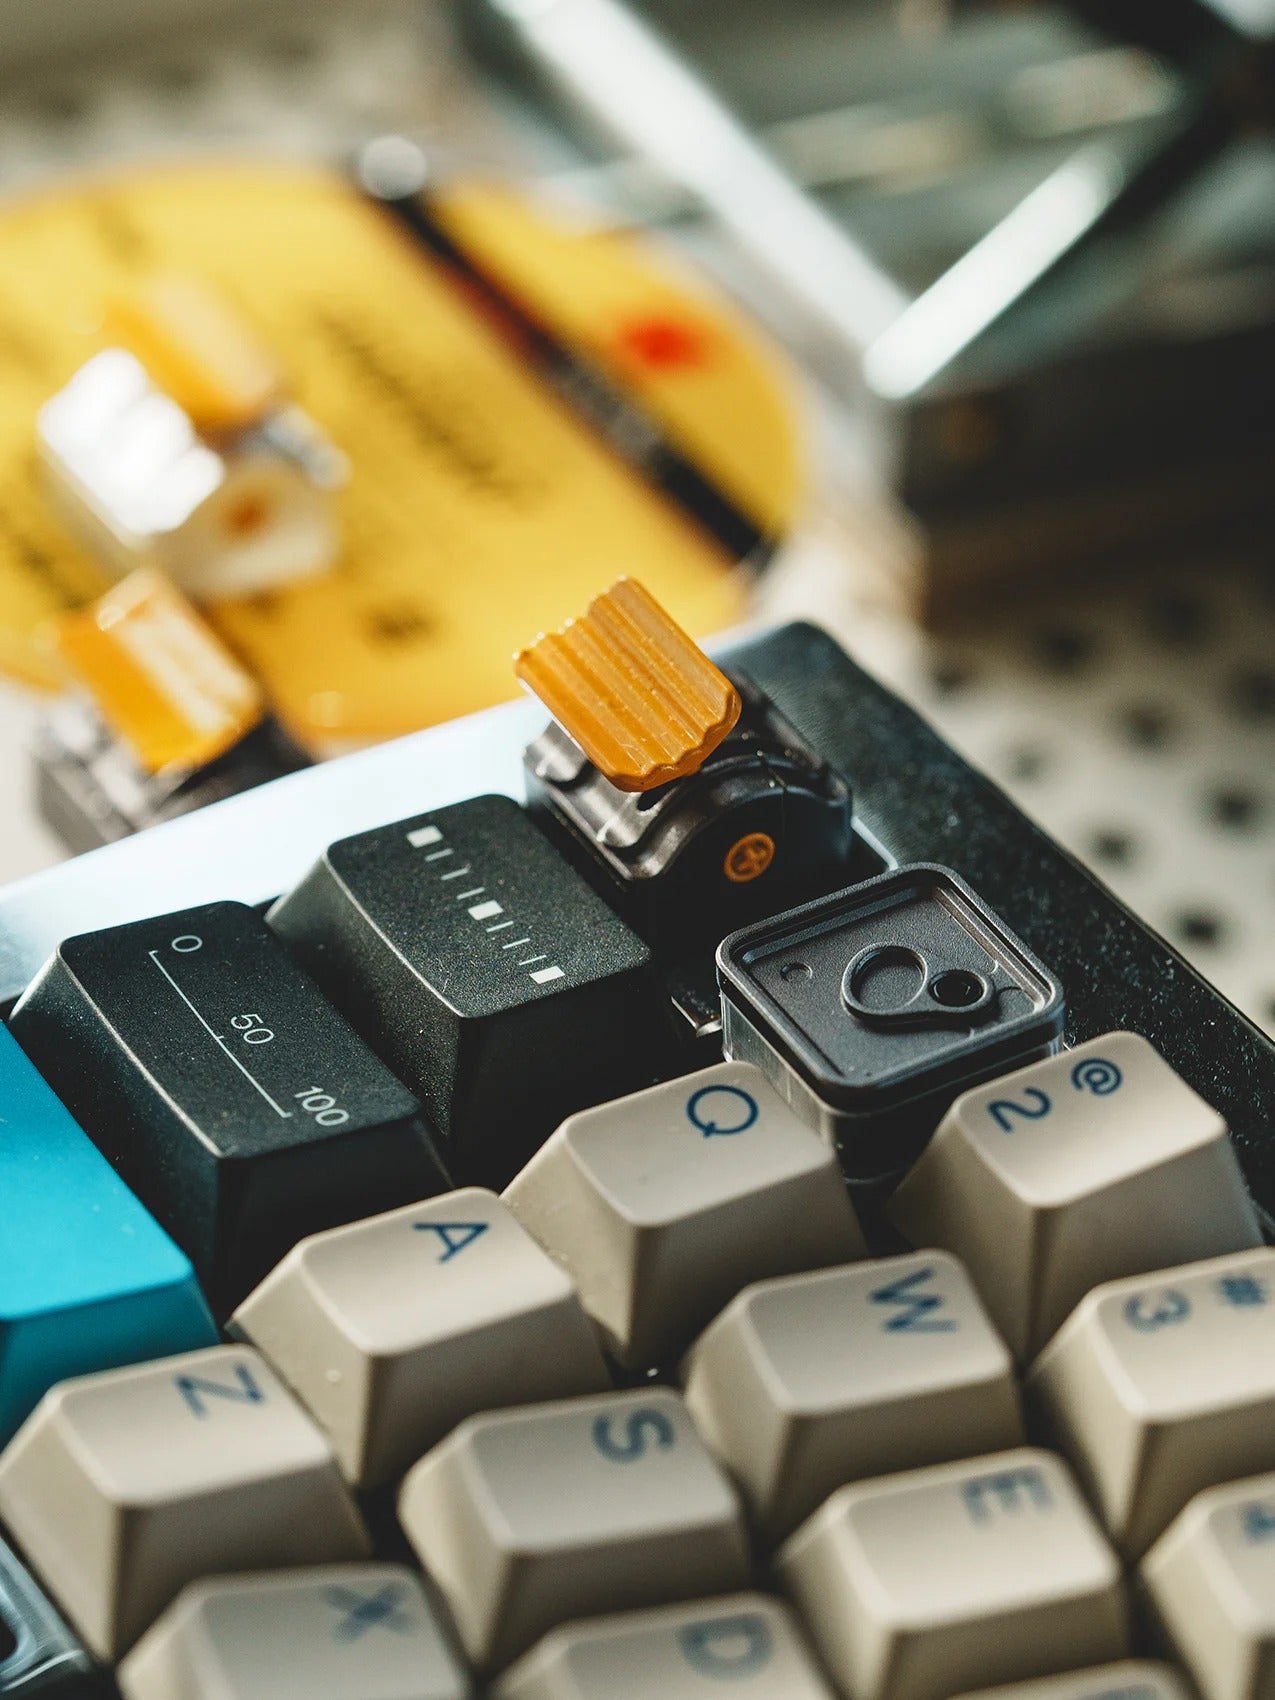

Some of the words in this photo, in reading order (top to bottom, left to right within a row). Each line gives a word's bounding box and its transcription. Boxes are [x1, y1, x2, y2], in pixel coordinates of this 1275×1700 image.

[171, 935, 203, 953] 0
[230, 1013, 274, 1045] 50
[1070, 1058, 1123, 1096] @
[293, 1085, 350, 1127] 100
[686, 1084, 759, 1138] Q
[987, 1087, 1052, 1134] 2
[412, 1222, 490, 1264] A
[869, 1268, 957, 1334] W
[1122, 1288, 1191, 1334] 3
[176, 1365, 264, 1416] Z
[592, 1408, 675, 1464] S
[963, 1467, 1052, 1526] E
[326, 1583, 414, 1643] X
[679, 1613, 772, 1680] D
